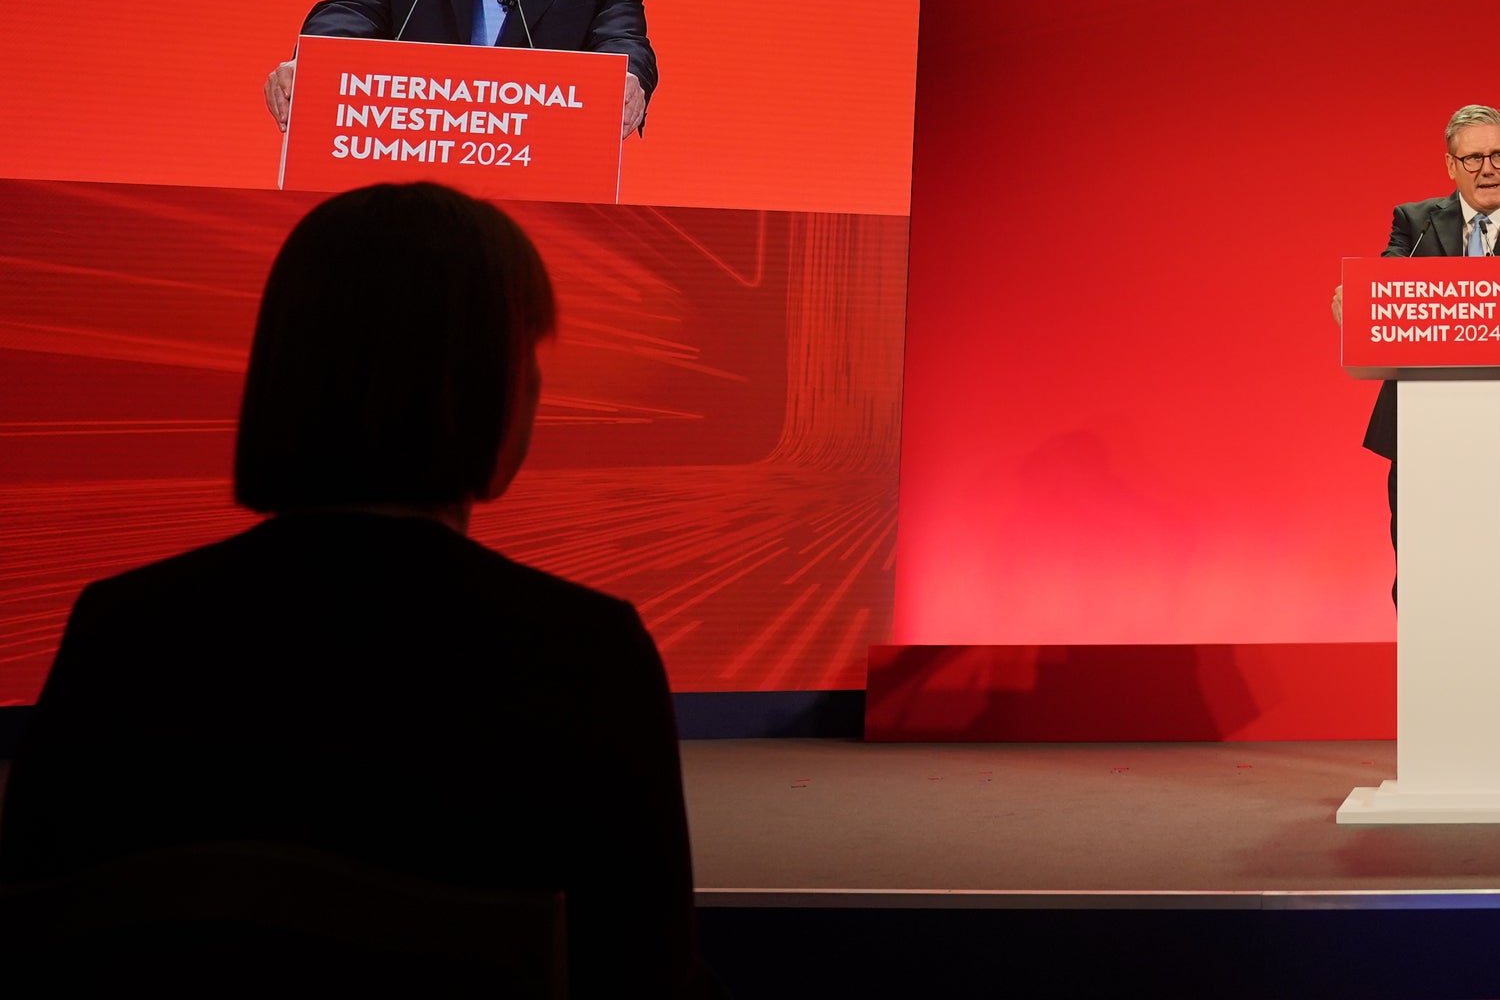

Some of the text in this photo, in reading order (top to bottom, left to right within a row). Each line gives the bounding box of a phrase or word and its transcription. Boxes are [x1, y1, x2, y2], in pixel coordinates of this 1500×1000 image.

[339, 72, 583, 108] INTERNATIONAL
[336, 103, 528, 136] INVESTMENT
[331, 135, 531, 167] SUMMIT 2024
[1371, 302, 1497, 321] INVESTMENT
[1370, 325, 1451, 343] SUMMIT
